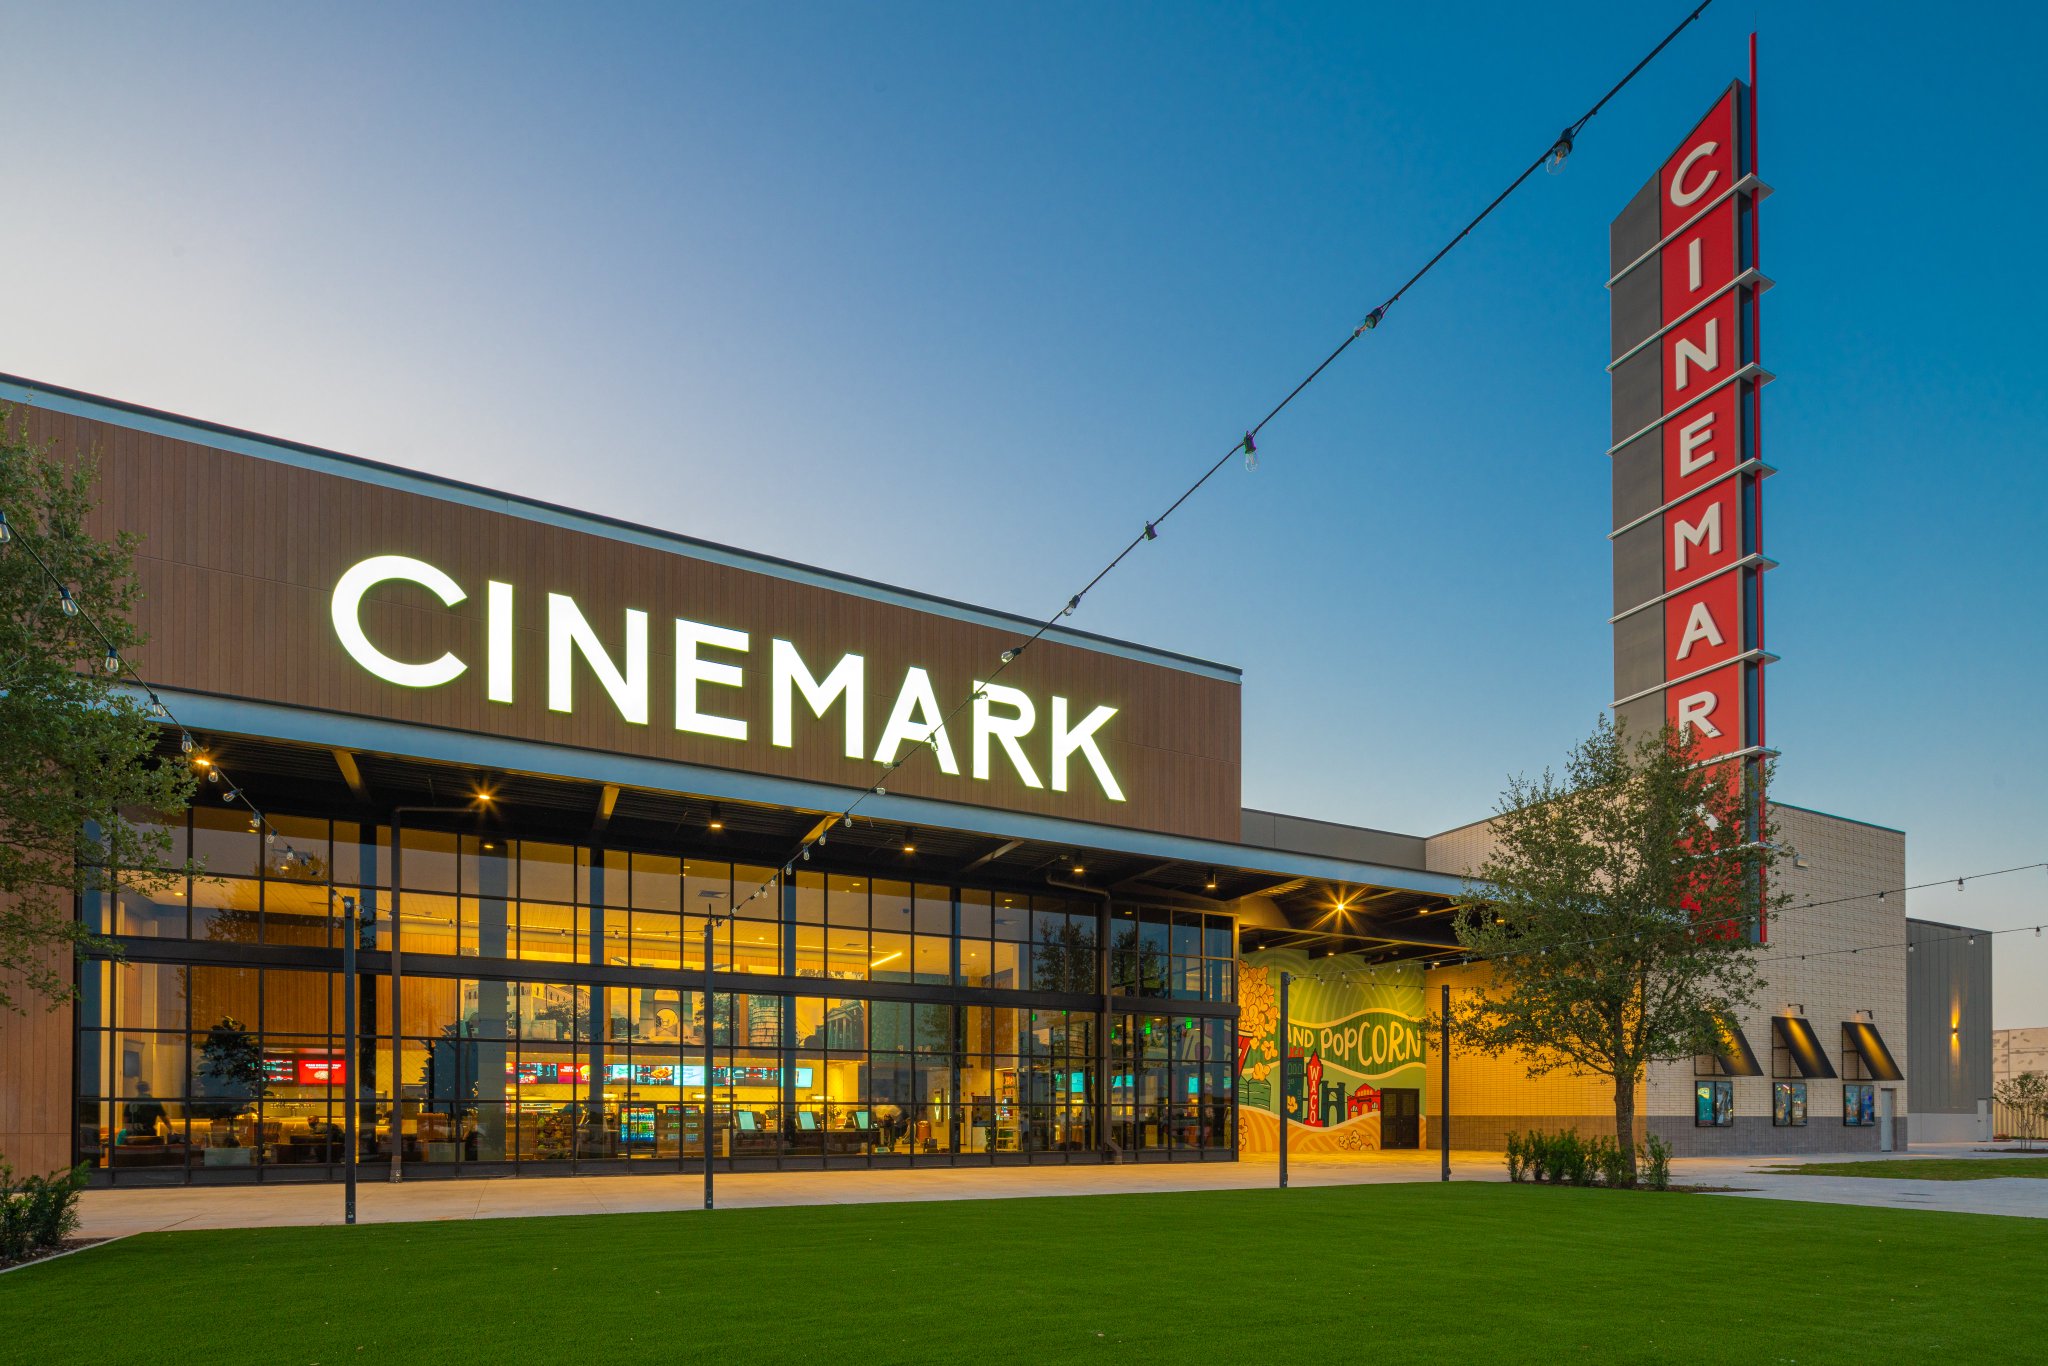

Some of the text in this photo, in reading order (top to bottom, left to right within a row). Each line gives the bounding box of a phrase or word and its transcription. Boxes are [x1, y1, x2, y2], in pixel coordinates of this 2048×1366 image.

[331, 555, 1126, 802] CINEMARK
[1320, 1021, 1421, 1067] POPCORN
[1309, 1065, 1321, 1124] WACO
